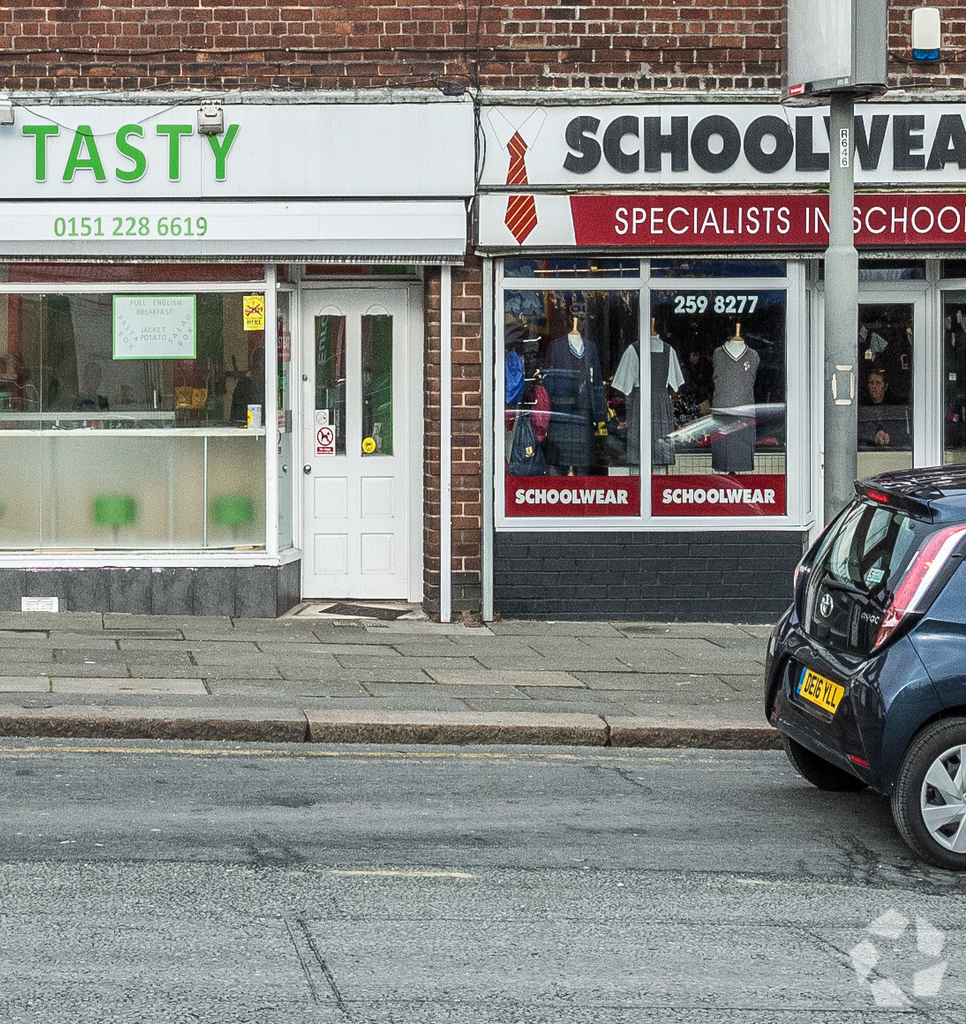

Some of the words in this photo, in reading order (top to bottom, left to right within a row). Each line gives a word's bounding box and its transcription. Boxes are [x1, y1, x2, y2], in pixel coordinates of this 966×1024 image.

[22, 124, 240, 181] TASTY
[54, 216, 105, 237] 0151
[112, 216, 150, 237] 228
[157, 216, 208, 237] 6619
[614, 206, 791, 235] SPECIALISTS
[805, 206, 831, 234] IN
[852, 206, 966, 234] SCHOO
[674, 295, 709, 314] 259
[714, 295, 758, 314] 8277
[117, 314, 139, 343] PASTA
[168, 314, 192, 344] SALAD
[177, 327, 193, 347] BOX
[118, 331, 134, 350] BOX
[515, 489, 628, 504] SCHOOLWEAR
[662, 488, 775, 504] SCHOOLWEAR
[804, 672, 822, 696] DE16
[821, 682, 837, 707] YLL
